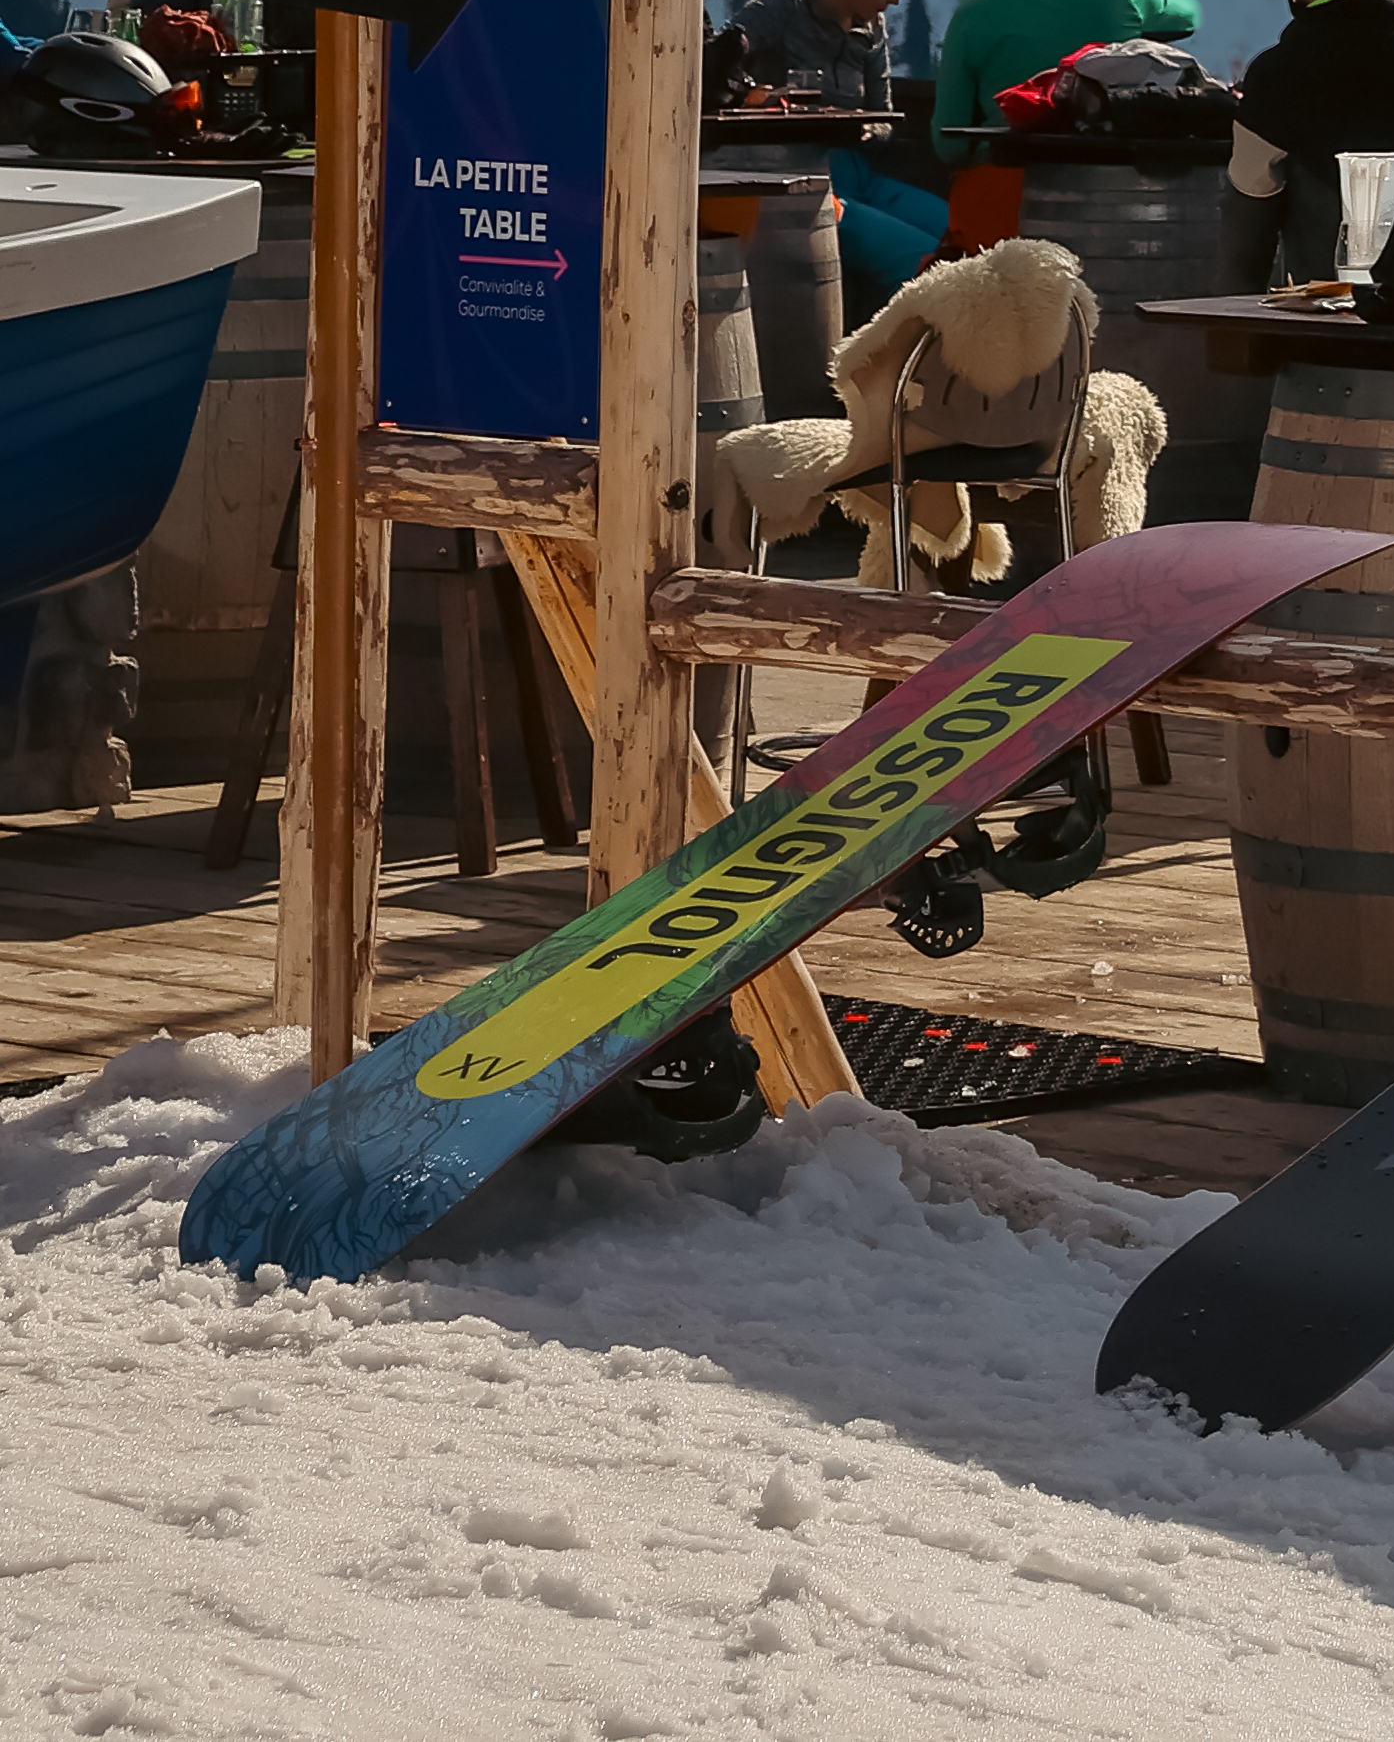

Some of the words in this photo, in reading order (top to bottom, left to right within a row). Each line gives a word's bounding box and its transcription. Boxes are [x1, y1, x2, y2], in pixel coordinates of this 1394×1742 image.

[414, 157, 450, 189] LA
[456, 159, 549, 195] PETITE
[459, 207, 548, 243] TABLE
[459, 275, 533, 297] Convivialité
[535, 280, 546, 297] &
[458, 299, 546, 322] Gourmandise
[586, 671, 1069, 970] ROSSIGNOL
